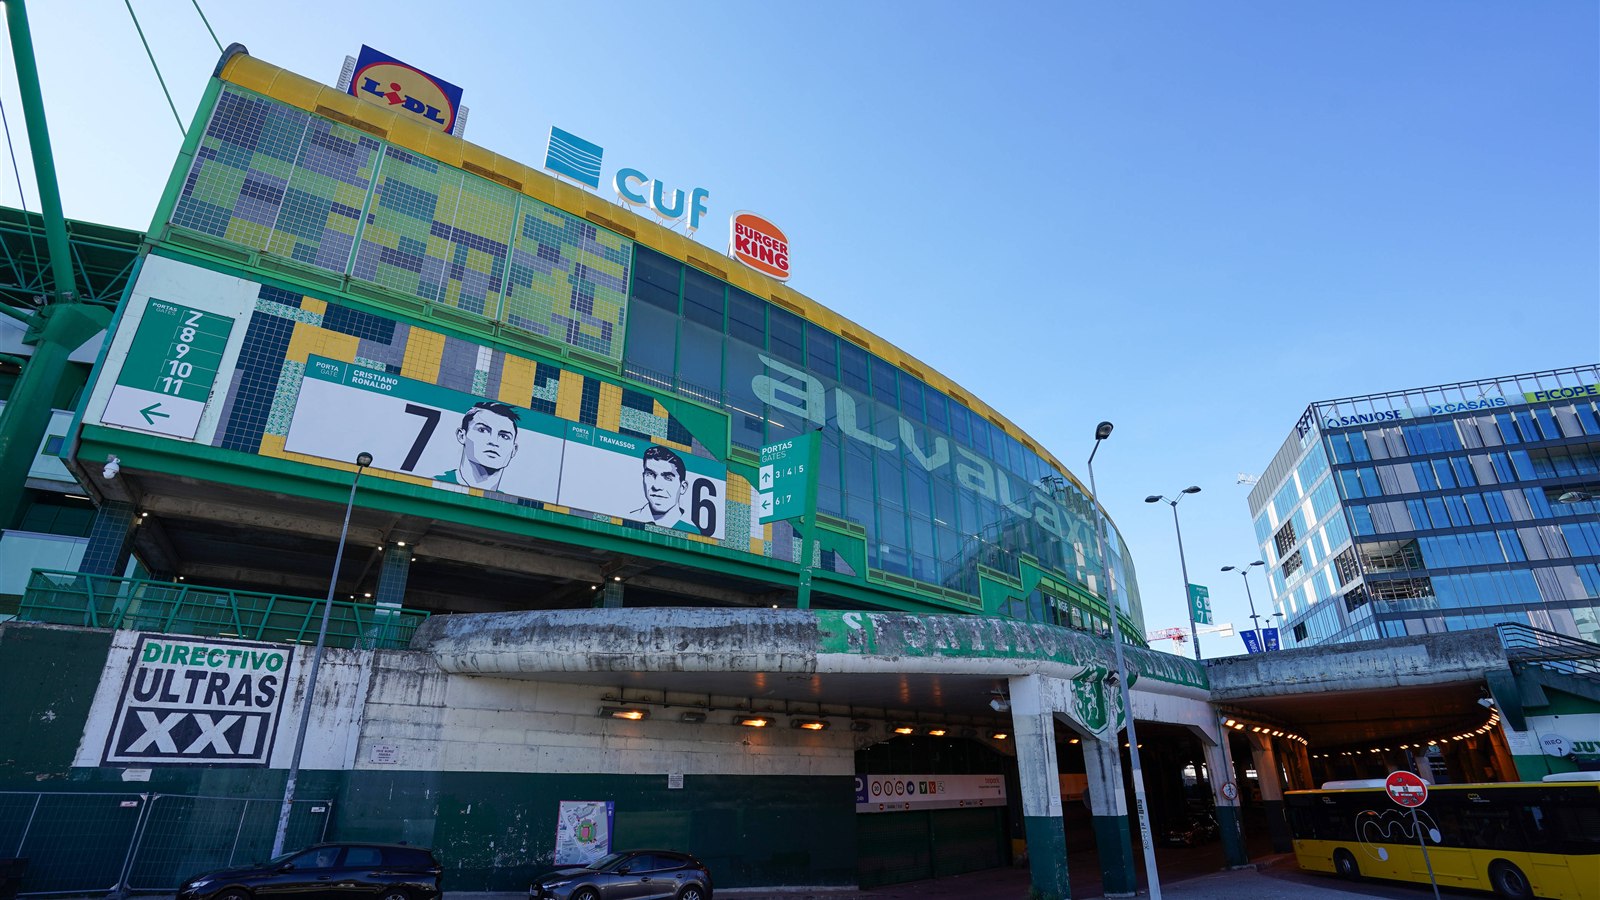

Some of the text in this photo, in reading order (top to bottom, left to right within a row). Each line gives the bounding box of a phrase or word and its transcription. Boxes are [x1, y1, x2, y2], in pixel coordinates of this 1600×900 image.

[735, 222, 788, 256] BURGER
[735, 233, 789, 271] KING
[152, 302, 178, 312] PORTAS
[155, 308, 176, 316] GATES
[180, 327, 196, 343] 8
[176, 343, 190, 359] 9
[169, 360, 193, 378] 10
[316, 361, 339, 372] PORTA
[320, 369, 338, 378] GATE
[162, 376, 184, 395] 11
[352, 376, 392, 391] RONALDO
[353, 369, 398, 386] CRISTIANO
[1534, 384, 1597, 402] FICOPE
[1444, 397, 1506, 413] CASAIS
[400, 403, 441, 472] 7
[572, 426, 589, 435] PORTA
[599, 435, 636, 450] TRAVASSOS
[761, 441, 793, 456] PORTAS
[761, 450, 787, 463] GATES
[775, 470, 780, 479] 3
[798, 465, 804, 473] 5
[691, 477, 717, 537] 6
[775, 494, 792, 505] 6 7
[1196, 595, 1203, 609] 6
[1197, 610, 1204, 623] 7
[142, 642, 284, 672] DIRECTIVO
[133, 667, 278, 708] ULTRAS
[124, 710, 262, 755] XXI
